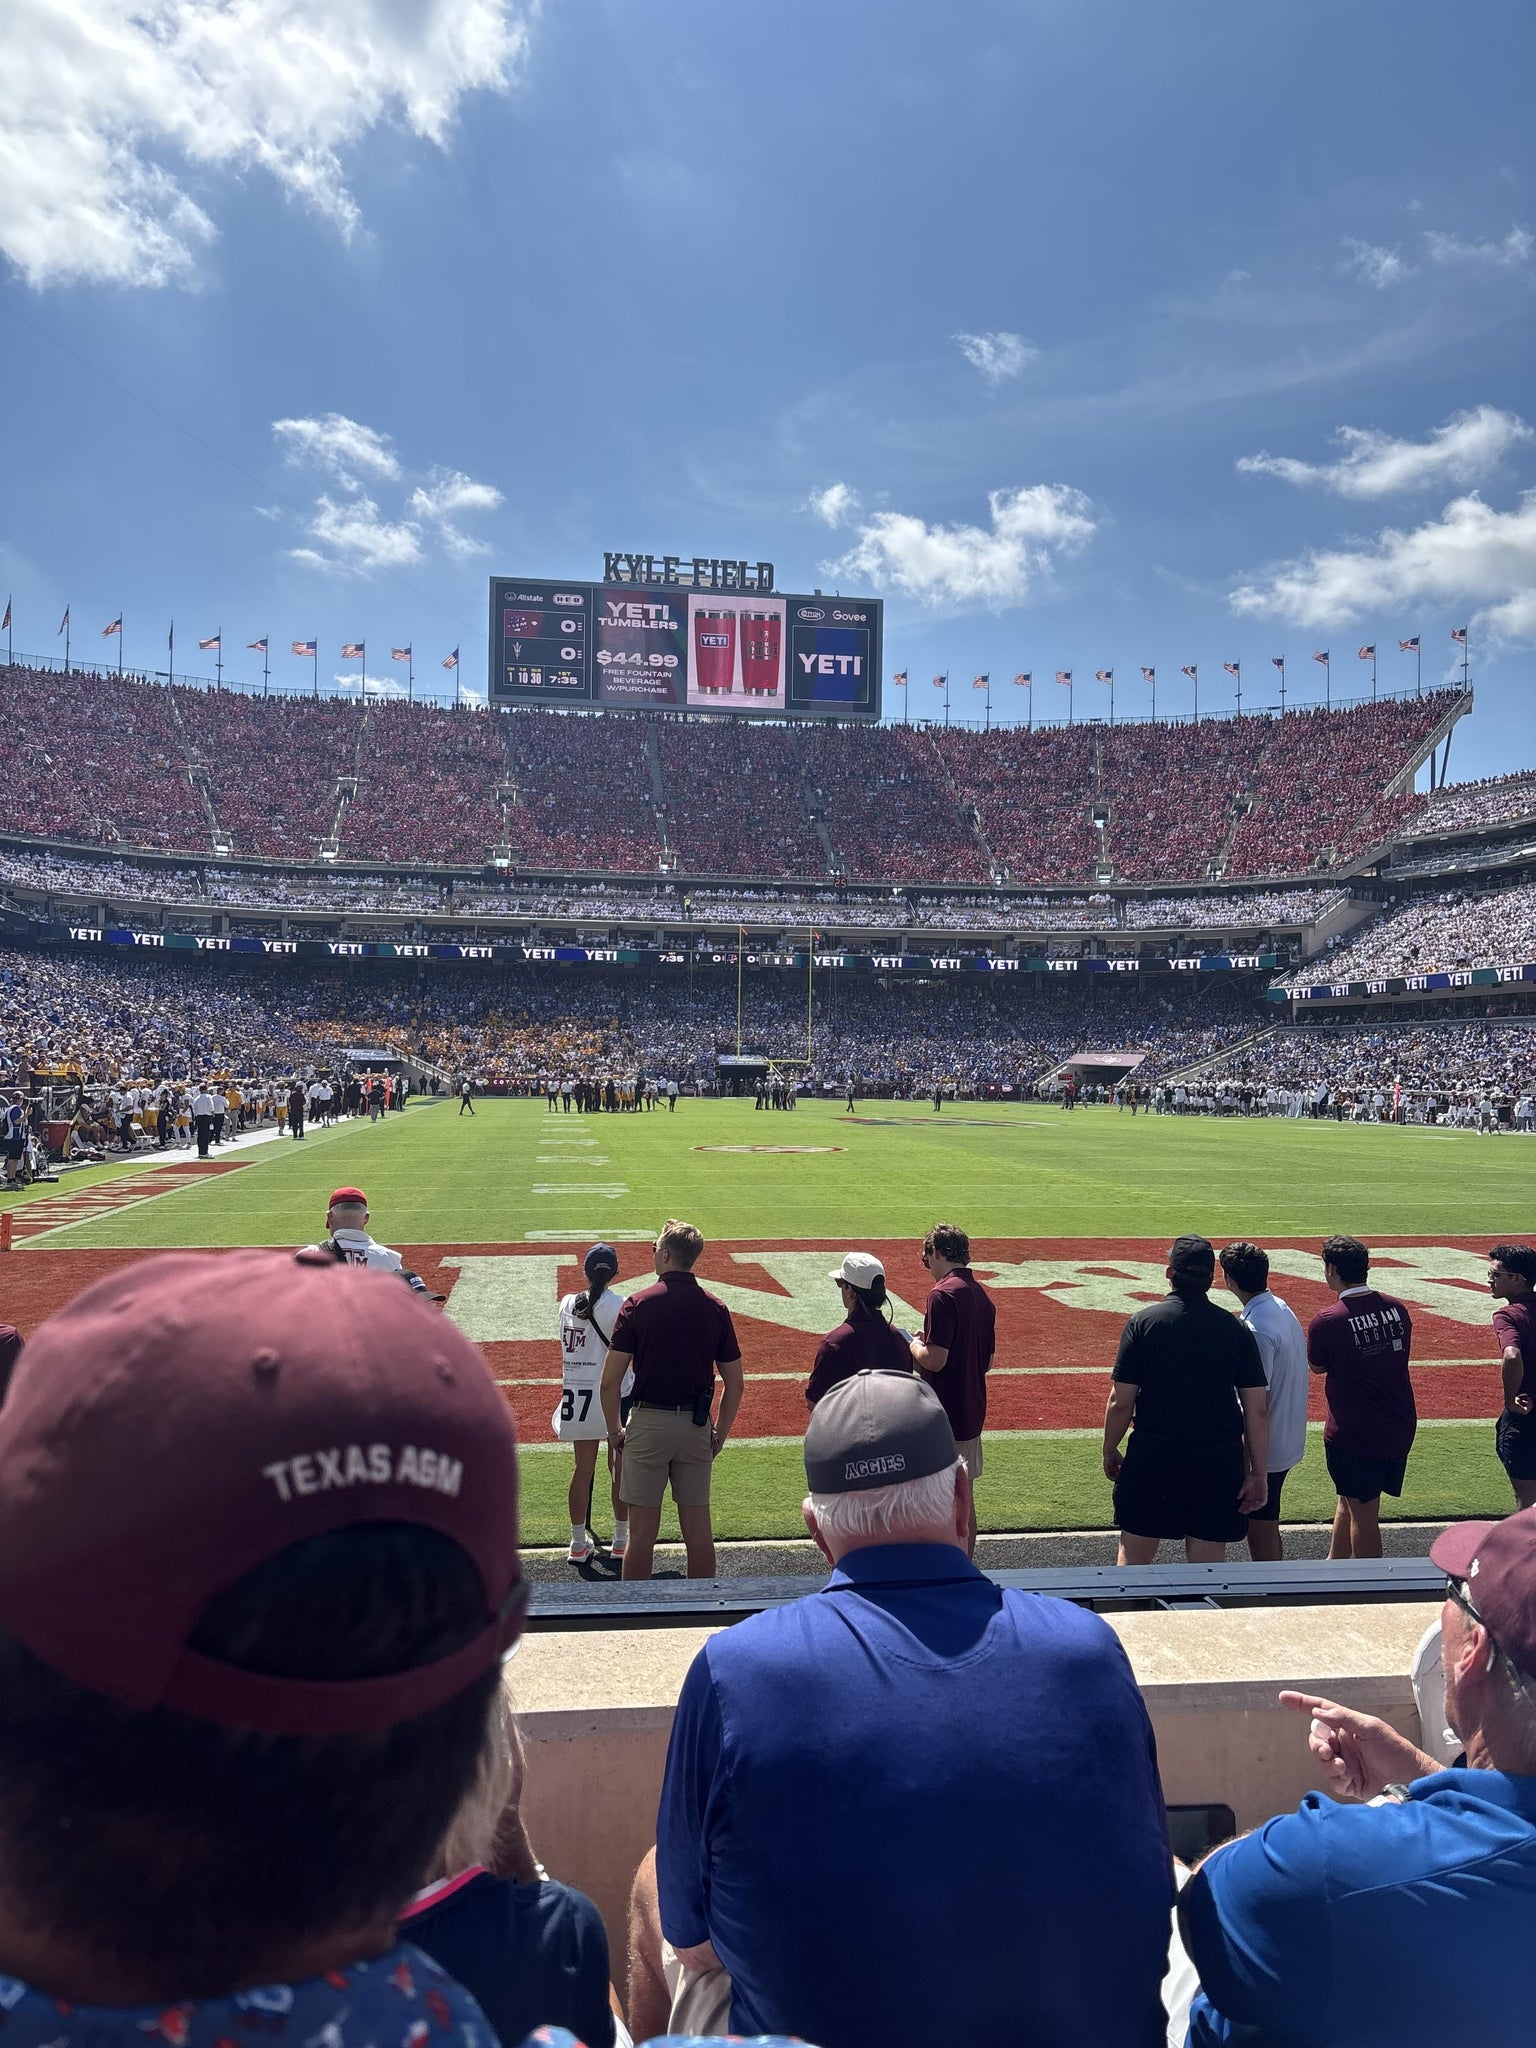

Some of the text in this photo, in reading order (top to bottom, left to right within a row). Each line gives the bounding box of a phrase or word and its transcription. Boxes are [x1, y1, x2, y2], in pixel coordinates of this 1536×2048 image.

[603, 552, 774, 591] KYLE FIELD
[517, 594, 544, 602] Allstate
[606, 601, 670, 619] YETI
[832, 610, 867, 622] Govee
[560, 620, 576, 633] 0
[598, 617, 678, 630] TUMBLERS
[701, 635, 727, 646] YETI
[560, 647, 576, 660] 0
[597, 650, 679, 668] $44.99
[798, 653, 862, 676] YETI
[508, 672, 542, 684] 1 10 30
[549, 675, 578, 685] 7:35
[602, 668, 672, 678] FREE FOUNTAIN
[613, 677, 662, 686] BEVERAGE
[606, 685, 668, 694] W/PURCHASE
[69, 927, 618, 961] YETI YETI YETI YETI YETI YETI YETI YETI YETI
[813, 955, 1259, 971] YETI YETI YETI YETI YETI YETI YETI YETI
[1285, 966, 1523, 1000] YETI YETI YETI YETI YETI YETI
[1347, 1307, 1401, 1332] TEXAS A&M
[1354, 1322, 1405, 1346] AGGIES
[262, 1442, 392, 1502] TEXAS
[845, 1454, 906, 1480] AGGIES
